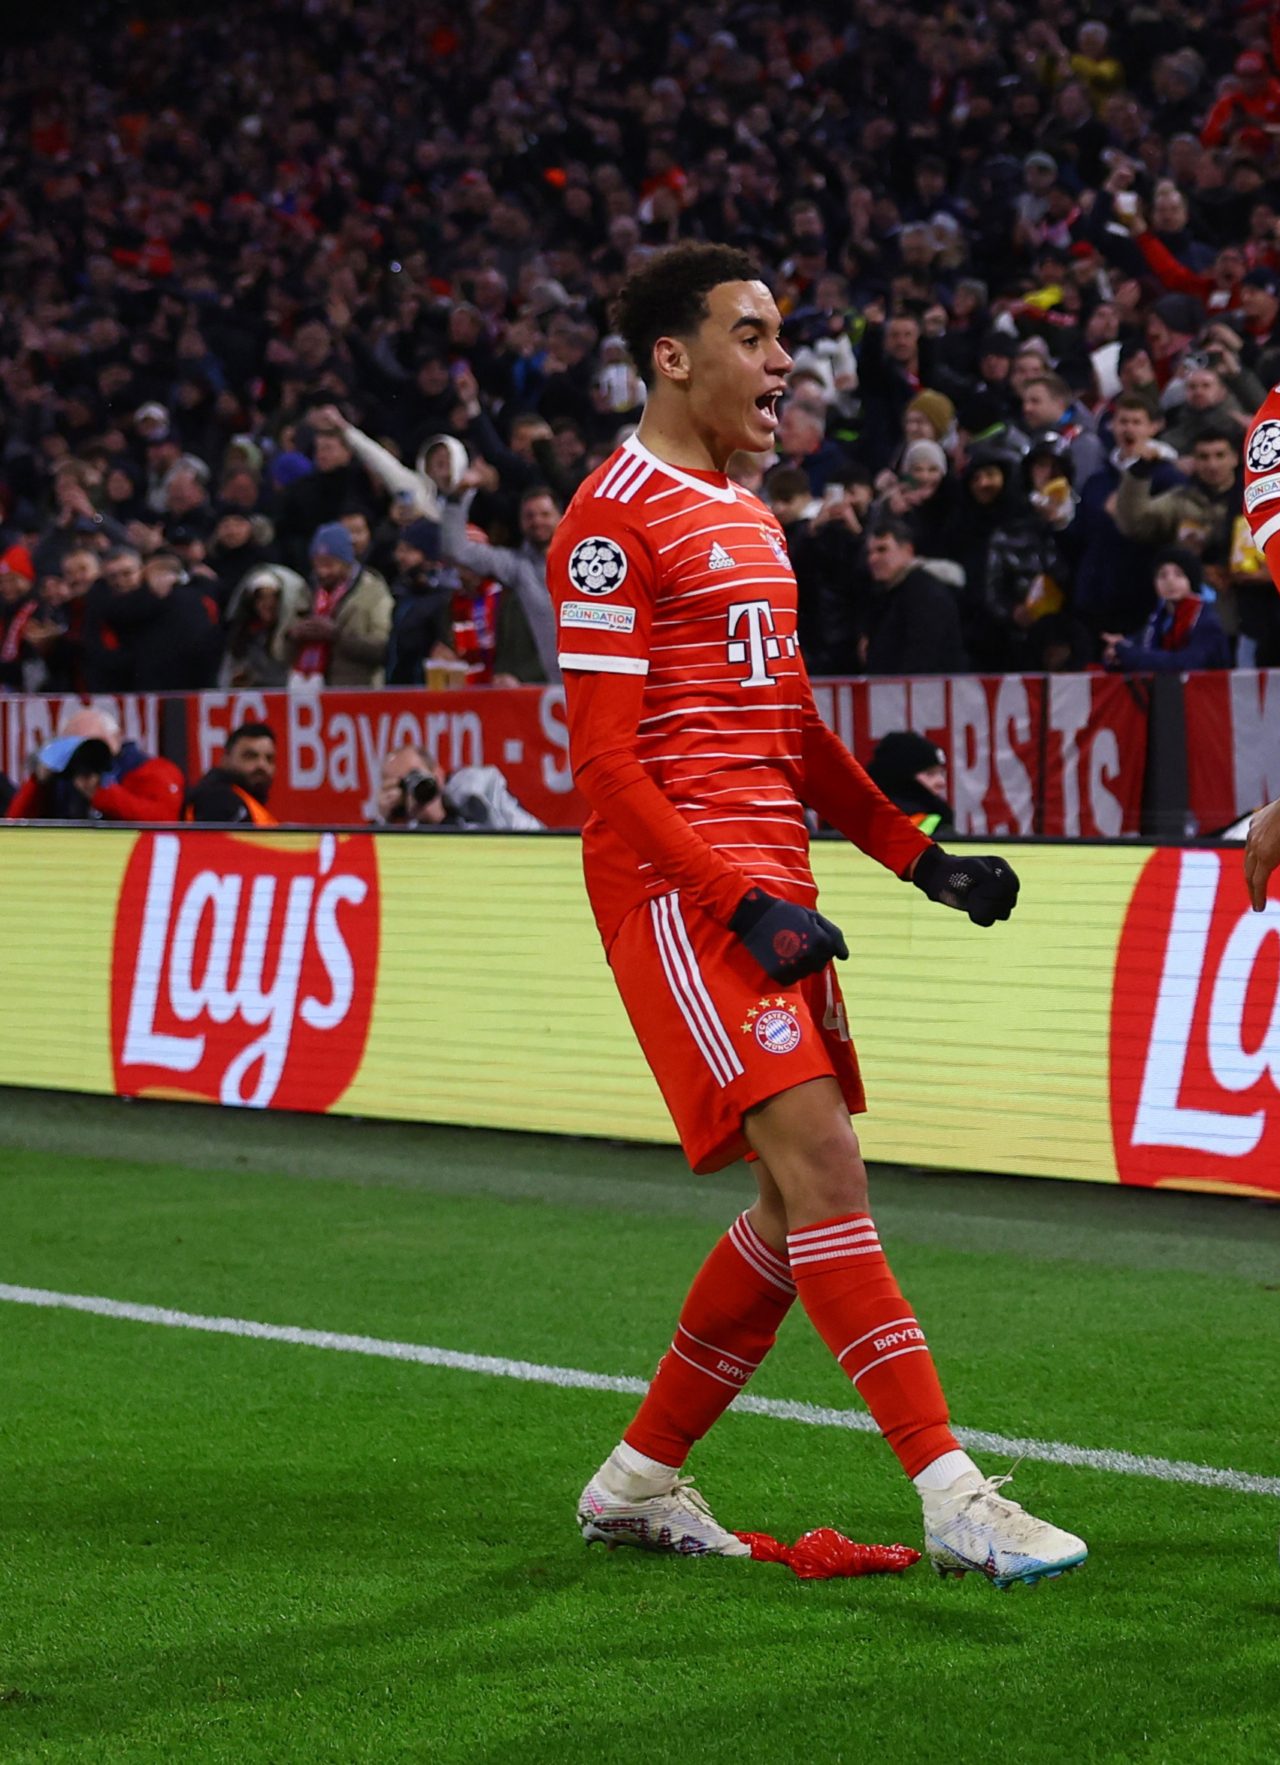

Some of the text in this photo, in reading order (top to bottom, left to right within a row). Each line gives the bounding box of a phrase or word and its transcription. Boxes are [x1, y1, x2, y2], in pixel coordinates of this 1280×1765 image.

[708, 557, 736, 570] adidas
[562, 609, 633, 624] FOUNDATION
[122, 834, 368, 1108] Lay's
[764, 1012, 793, 1026] BAYERN
[764, 1030, 798, 1051] MÜNCHEN
[873, 1327, 926, 1351] BAYER
